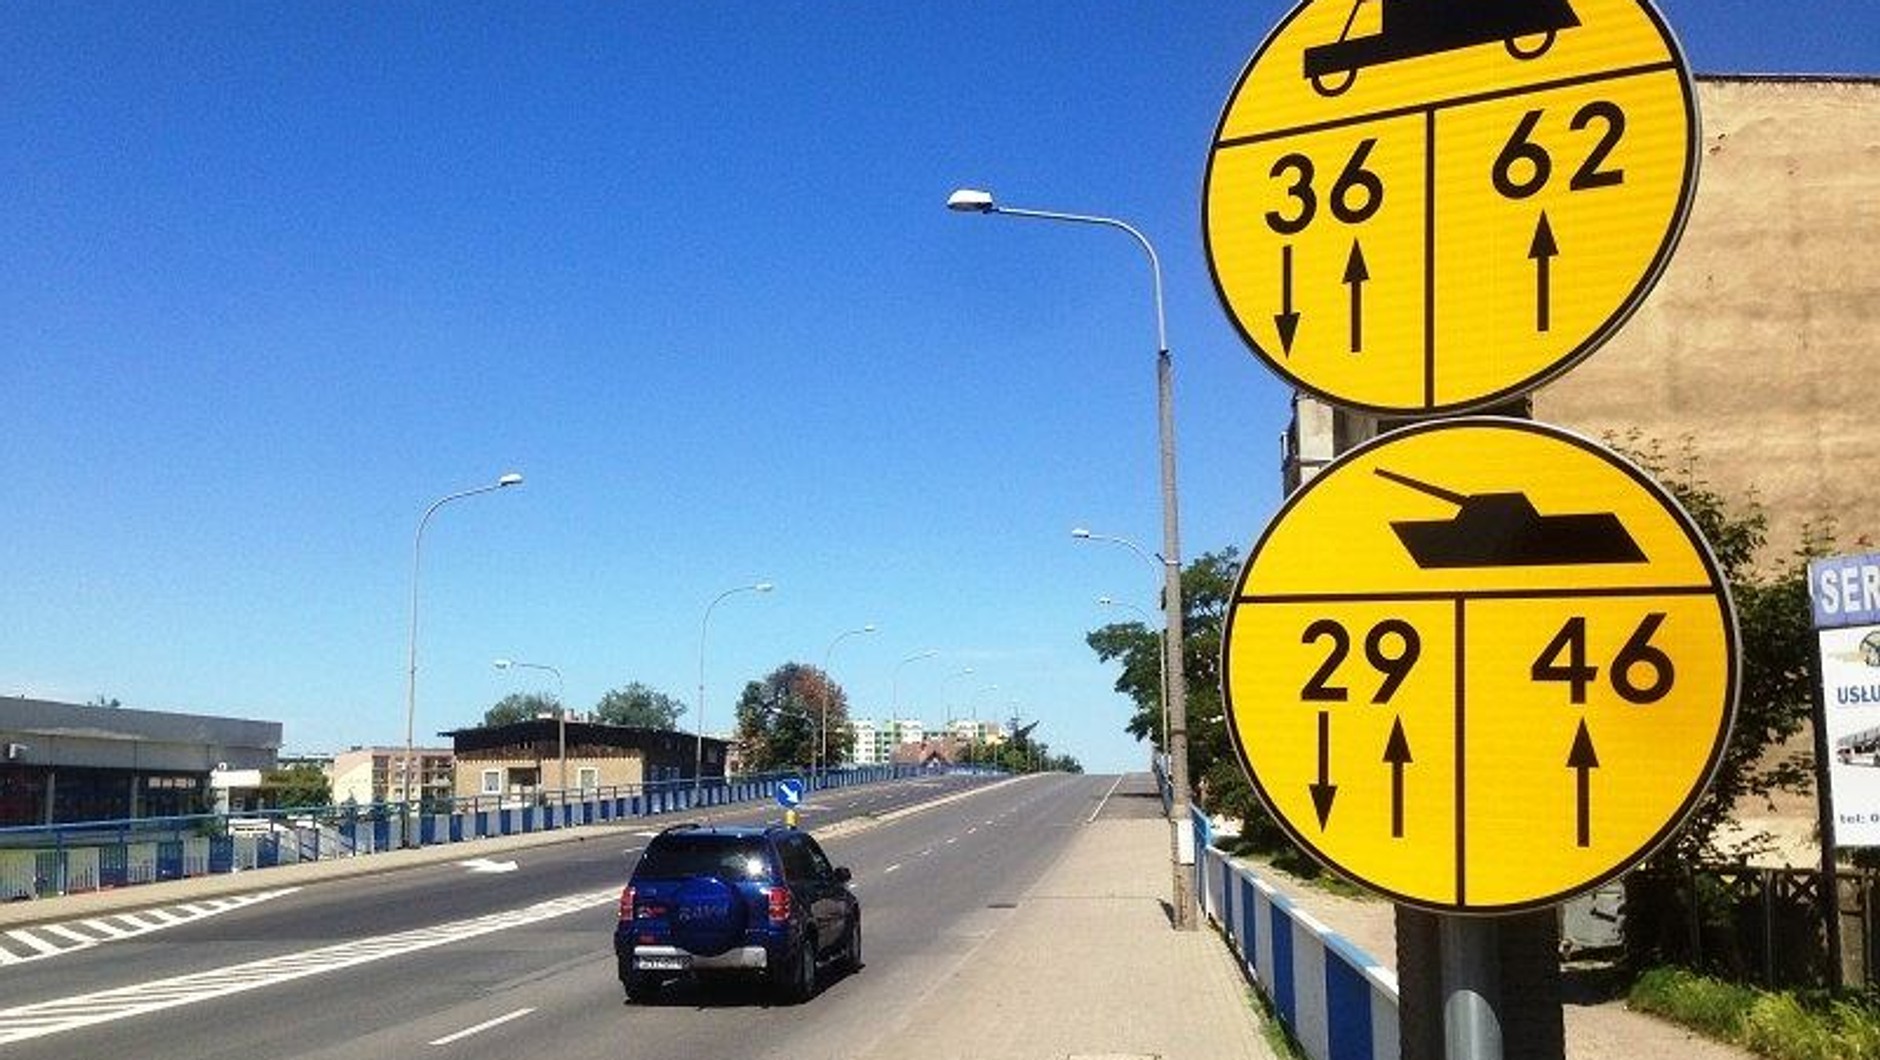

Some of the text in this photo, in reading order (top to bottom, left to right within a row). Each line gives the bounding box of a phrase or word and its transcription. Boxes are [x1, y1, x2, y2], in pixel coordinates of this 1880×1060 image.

[1265, 138, 1384, 235] 36
[1491, 100, 1626, 199] 62
[1300, 619, 1422, 704] 29
[1532, 613, 1676, 704] 46
